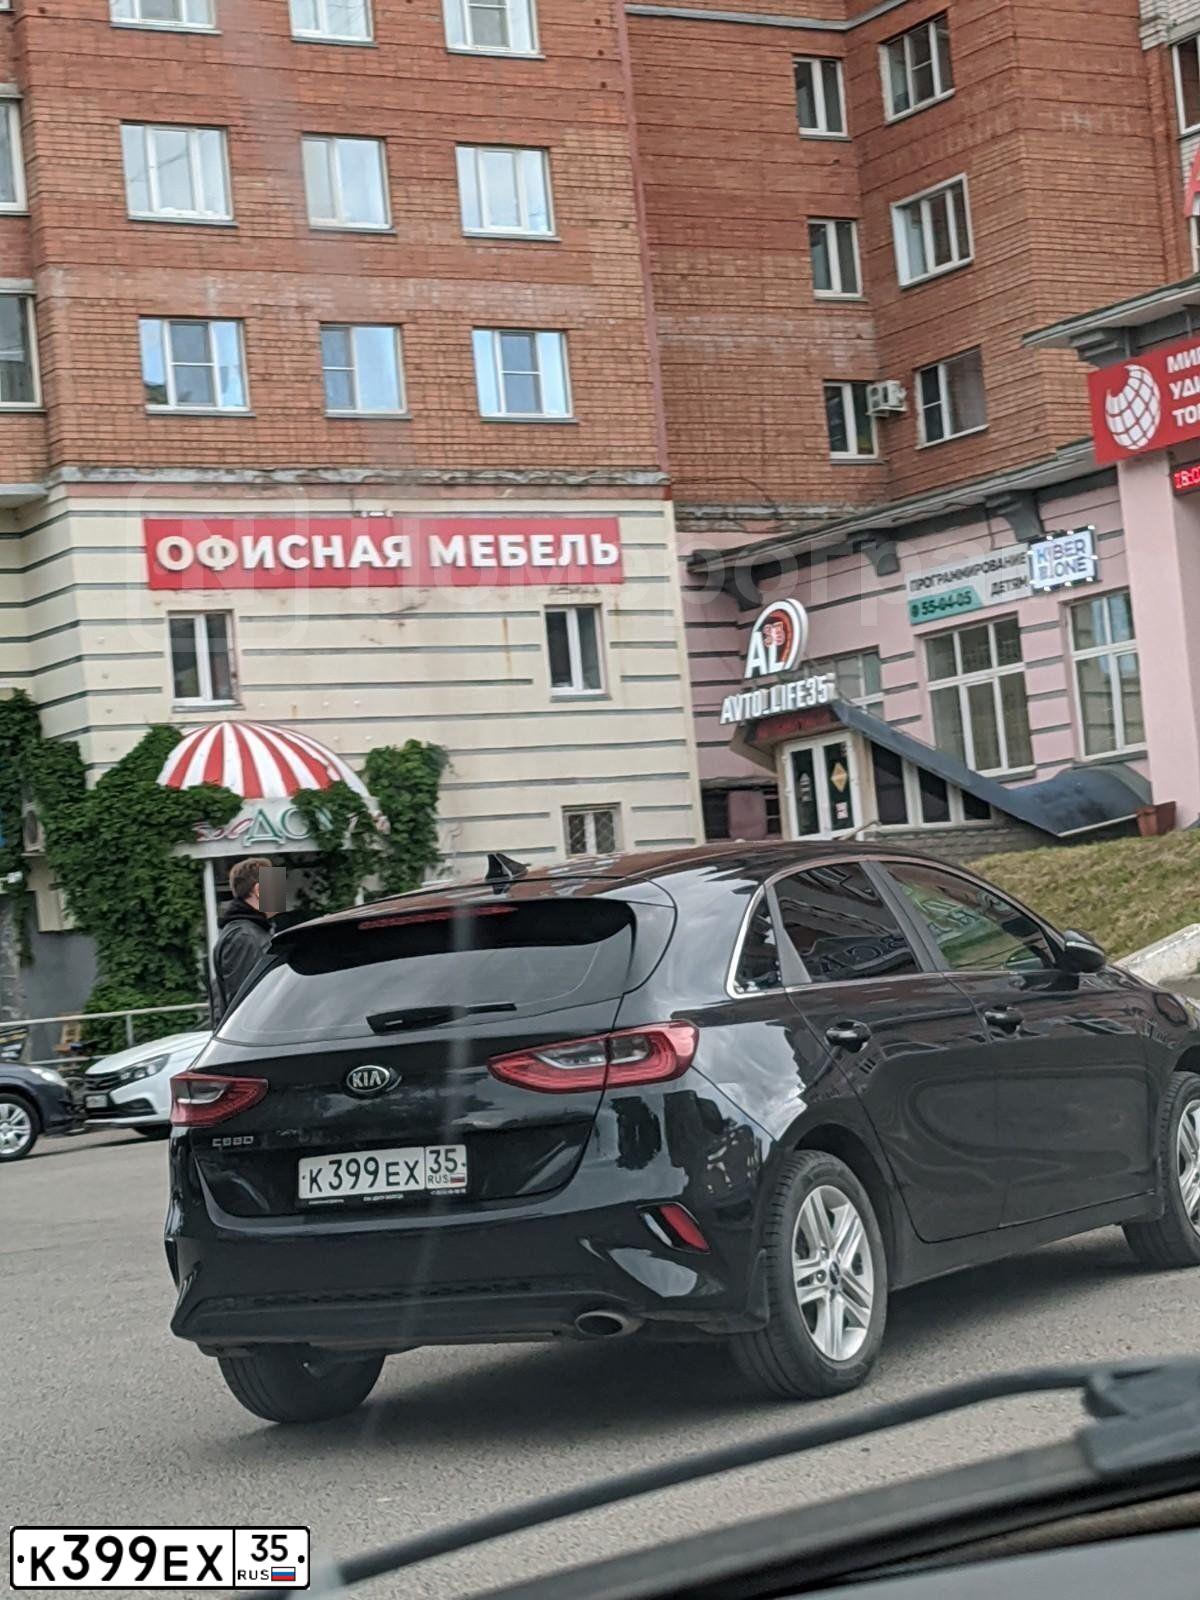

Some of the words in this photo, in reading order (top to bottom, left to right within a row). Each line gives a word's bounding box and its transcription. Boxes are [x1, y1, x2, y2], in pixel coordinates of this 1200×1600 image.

[1167, 346, 1200, 373] МИ
[1172, 403, 1200, 427] ТО
[157, 534, 412, 572] ОФИСНАЯ
[430, 533, 619, 569] МЕБЕЛЬ
[910, 551, 1027, 592] ПРОГРАММИРОВАНИЕ
[352, 1070, 382, 1088] KIA
[309, 1157, 419, 1193] К399ЕХ
[429, 1149, 458, 1174] 35
[428, 1174, 448, 1184] RUS
